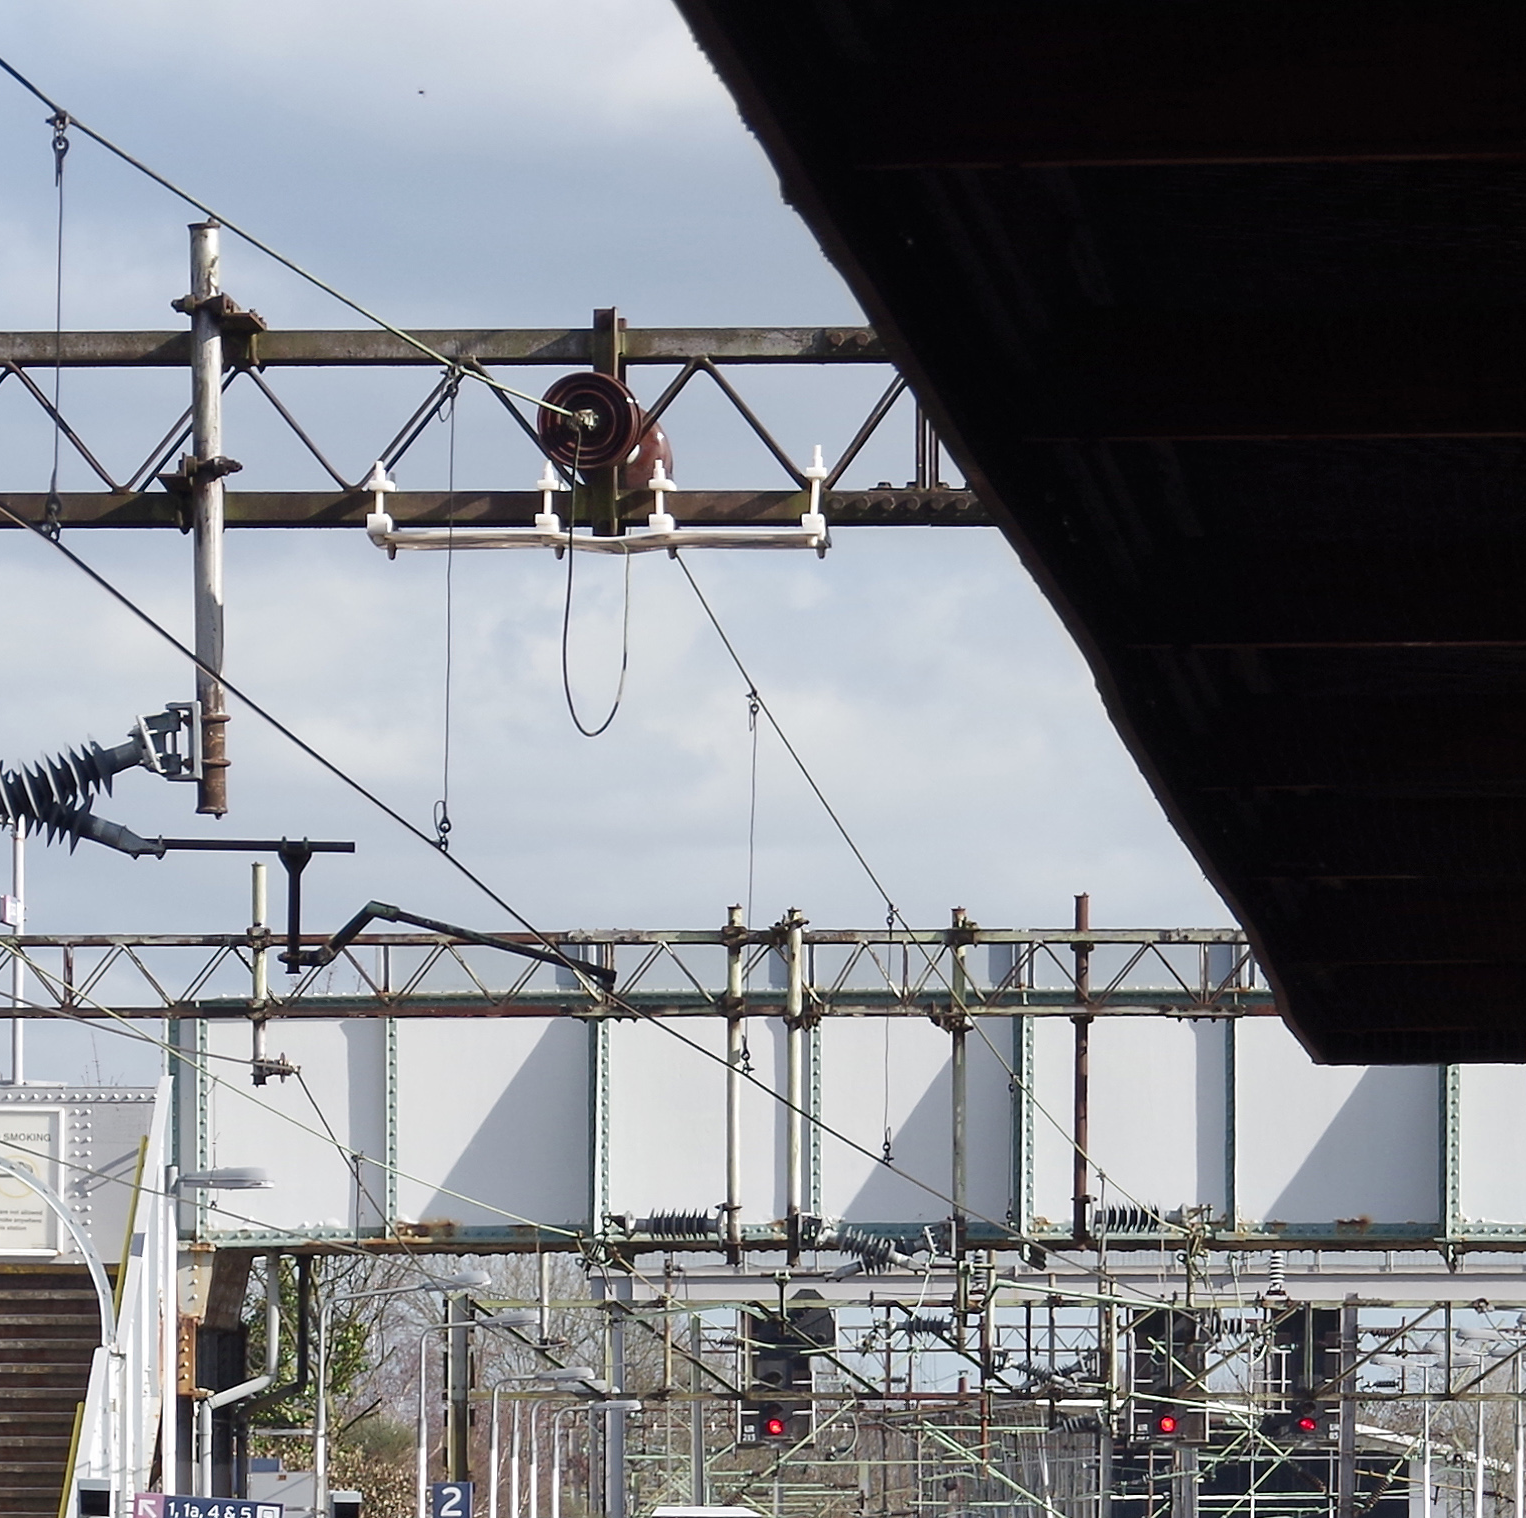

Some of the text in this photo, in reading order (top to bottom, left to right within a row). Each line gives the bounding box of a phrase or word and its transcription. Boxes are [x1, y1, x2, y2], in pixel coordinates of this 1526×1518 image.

[3, 1132, 51, 1142] SMOKING
[440, 1486, 463, 1517] 2
[168, 1502, 180, 1518] 1,
